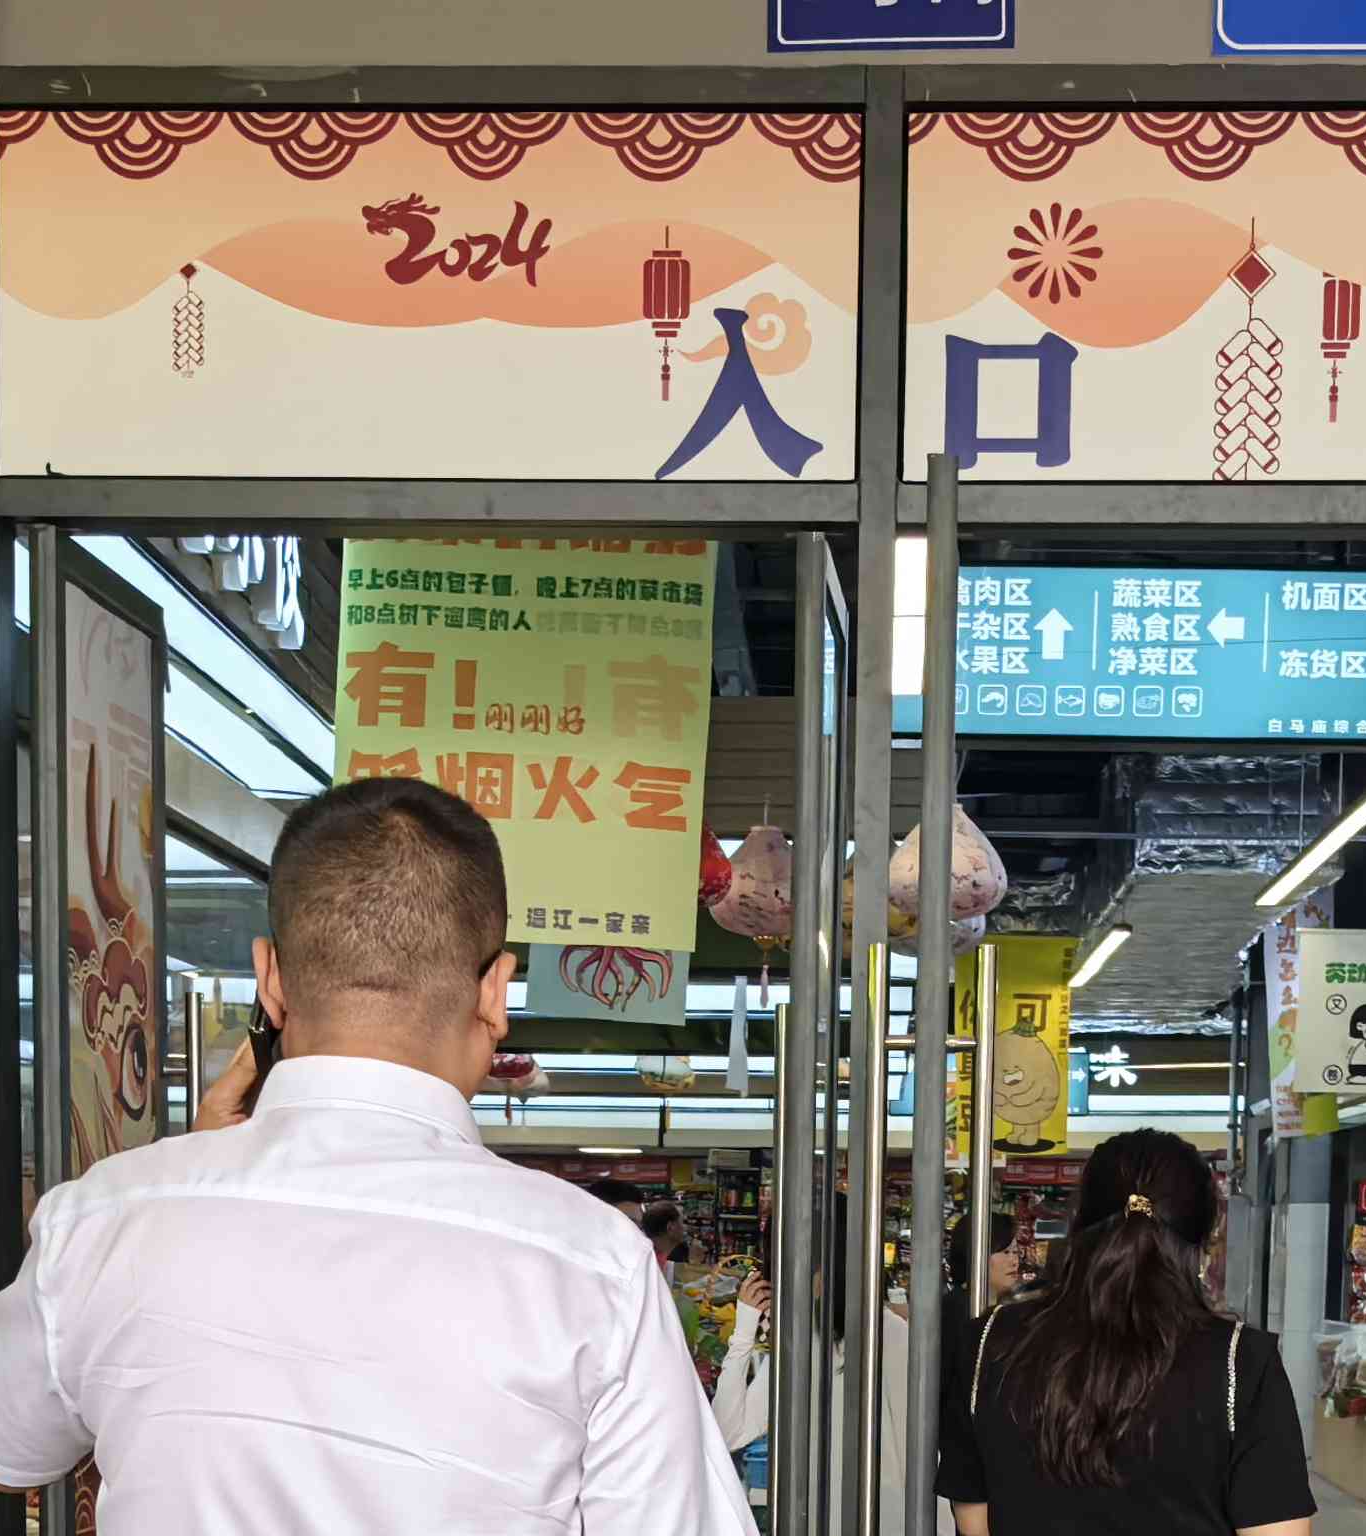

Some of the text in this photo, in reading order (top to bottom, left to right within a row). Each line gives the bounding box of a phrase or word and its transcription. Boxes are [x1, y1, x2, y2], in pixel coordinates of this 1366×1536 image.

[362, 192, 552, 288] 2024
[1112, 579, 1203, 608] 蔬菜区
[1110, 614, 1202, 642] 熟食区
[1107, 649, 1198, 677] 净菜区
